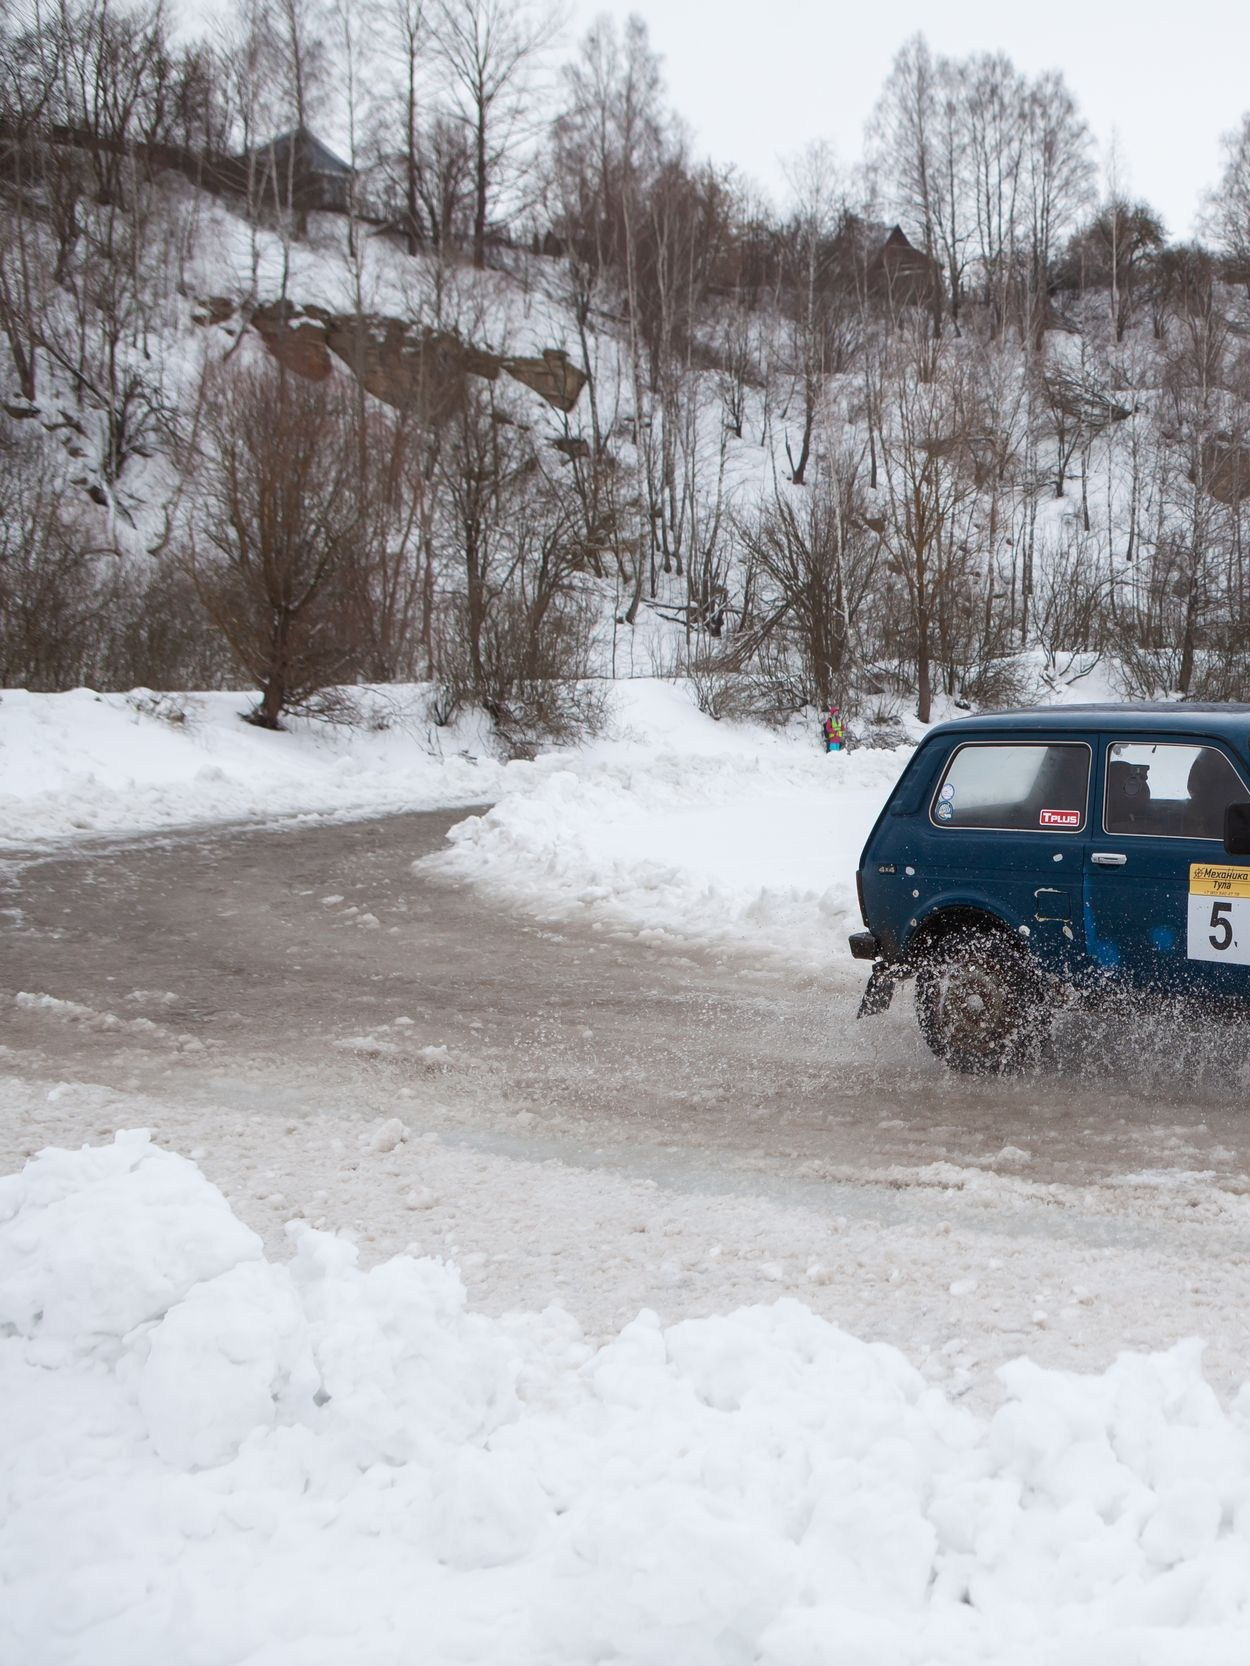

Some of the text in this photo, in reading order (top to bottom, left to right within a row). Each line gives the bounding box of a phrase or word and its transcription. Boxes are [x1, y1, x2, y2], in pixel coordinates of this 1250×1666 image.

[1203, 868, 1249, 880] Механика
[1213, 880, 1232, 890] Тула
[1208, 901, 1233, 951] 5
